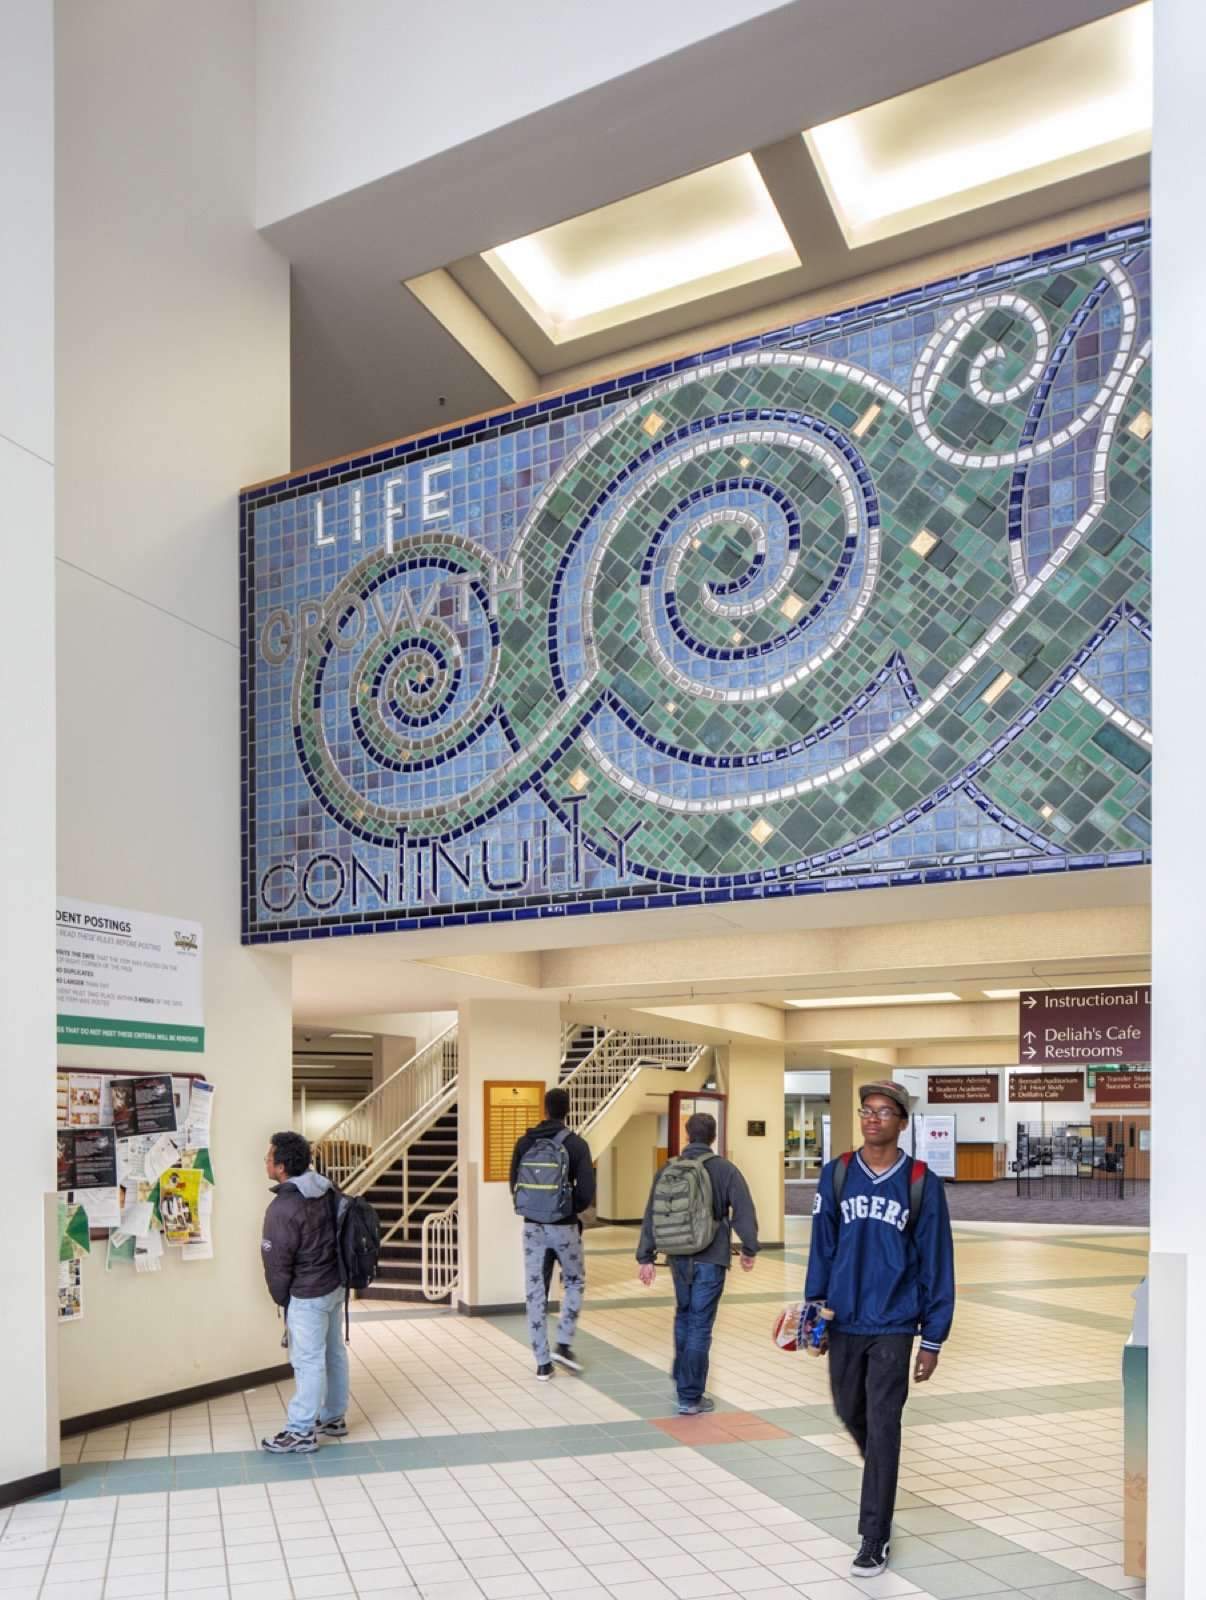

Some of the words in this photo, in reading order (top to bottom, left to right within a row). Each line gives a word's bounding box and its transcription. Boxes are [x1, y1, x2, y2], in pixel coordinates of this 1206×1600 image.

[314, 462, 453, 554] LIFE
[260, 558, 525, 667] GROWTH
[261, 792, 647, 914] CONTINUITY
[84, 914, 131, 933] POSTINGS
[1044, 990, 1138, 1008] Instructional
[1044, 1026, 1102, 1042] Deliah's
[1044, 1044, 1124, 1058] Restrooms
[840, 1195, 910, 1232] TIGERS
